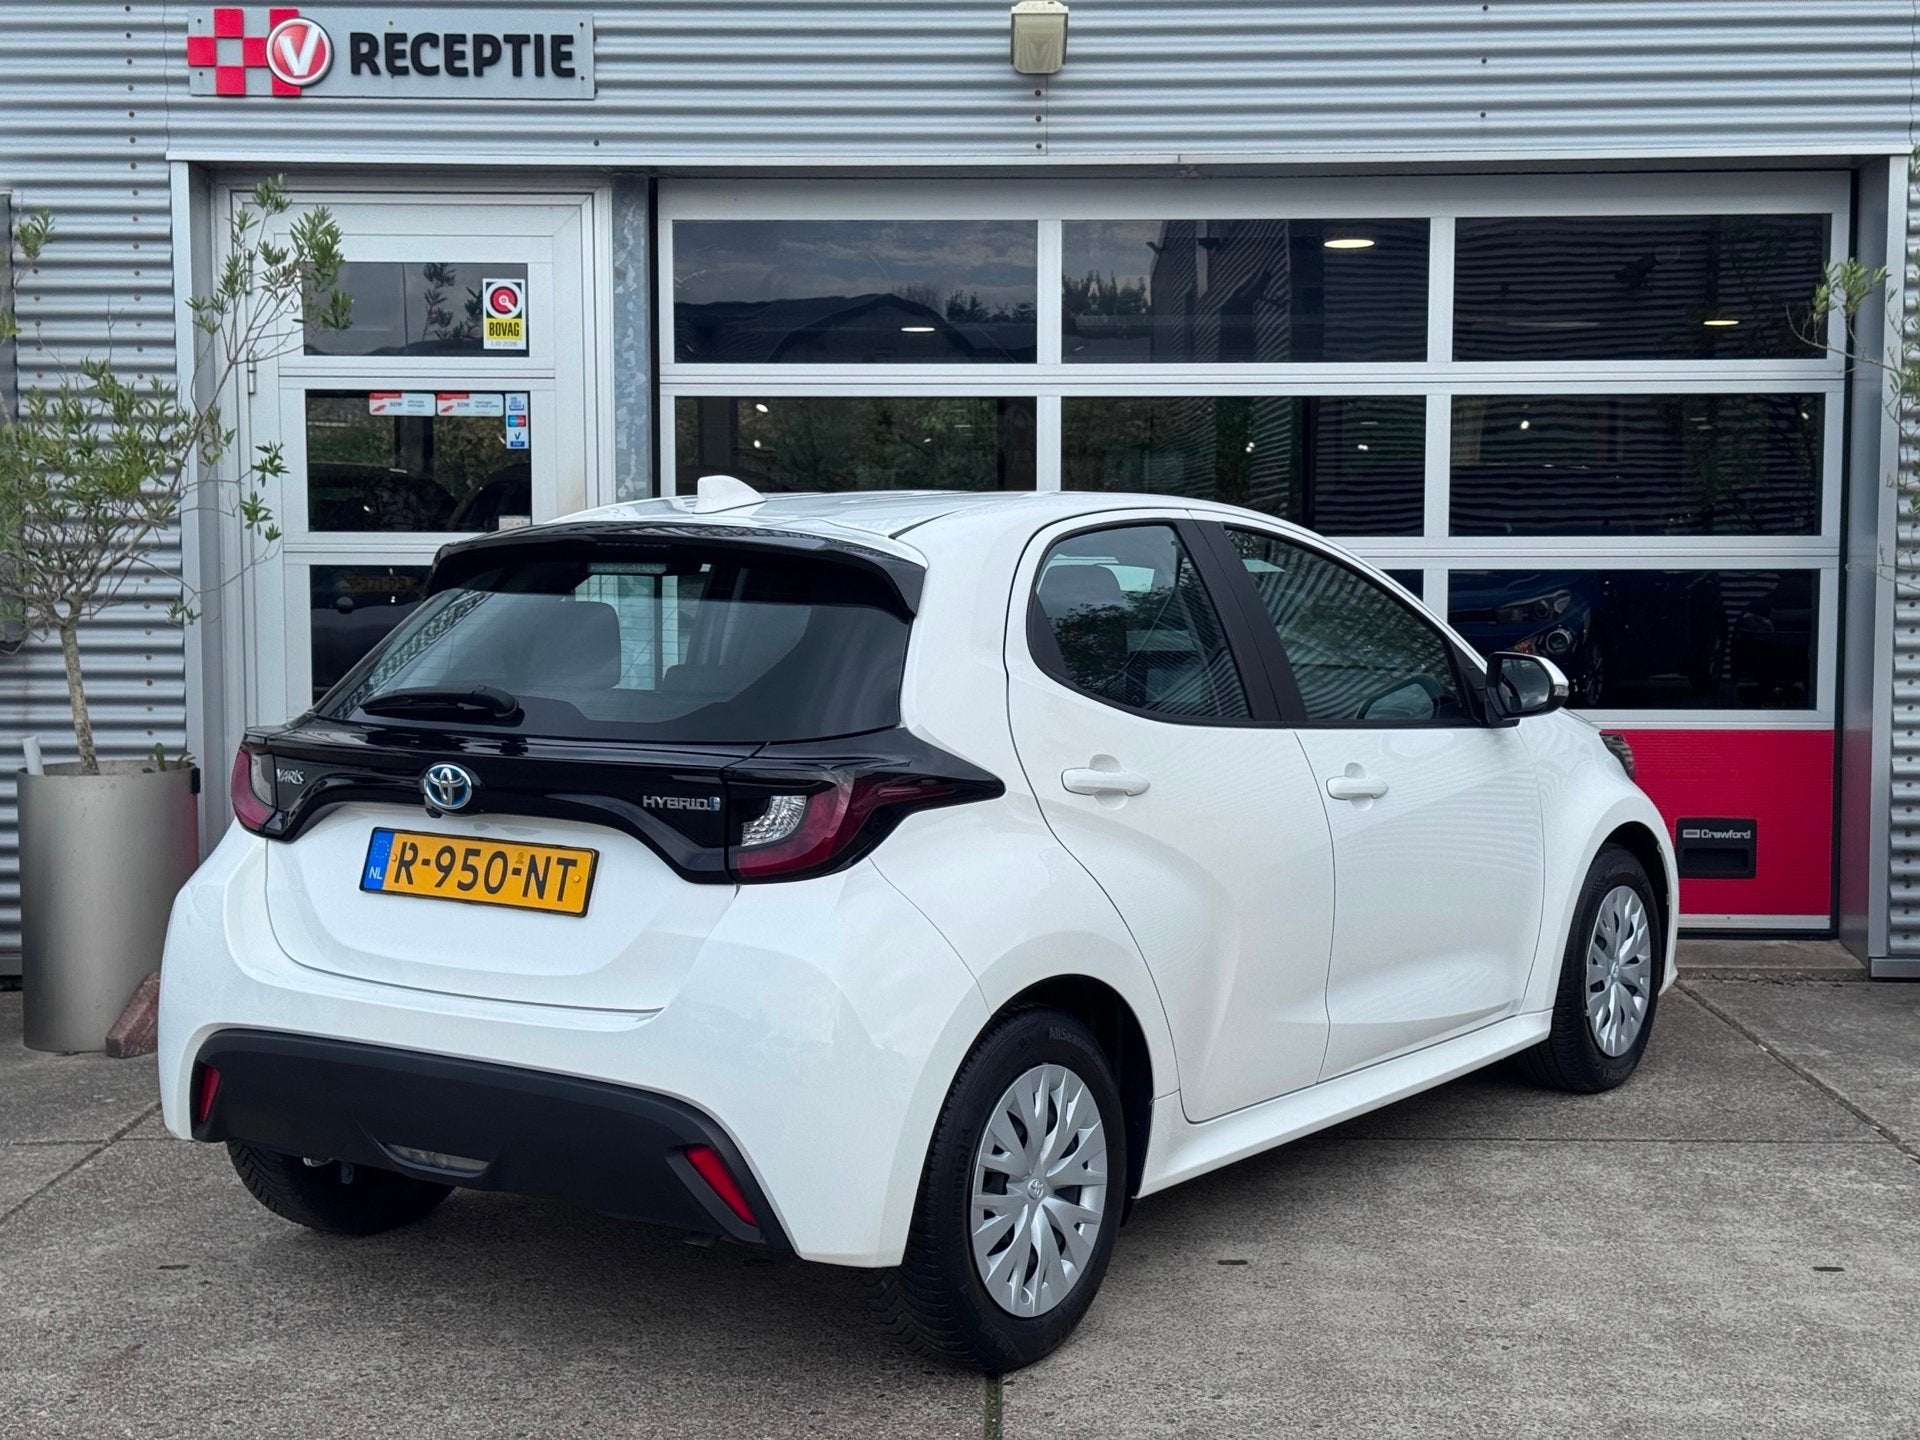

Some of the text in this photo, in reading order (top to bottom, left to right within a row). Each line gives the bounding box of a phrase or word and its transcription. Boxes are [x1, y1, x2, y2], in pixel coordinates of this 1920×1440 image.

[350, 32, 576, 78] RECEPTIE
[489, 322, 520, 337] BOVAG
[276, 767, 305, 785] YARIS
[642, 794, 708, 811] HYBRID
[1701, 829, 1751, 839] Crawford
[369, 867, 383, 880] NL
[394, 841, 578, 902] R-950-NT
